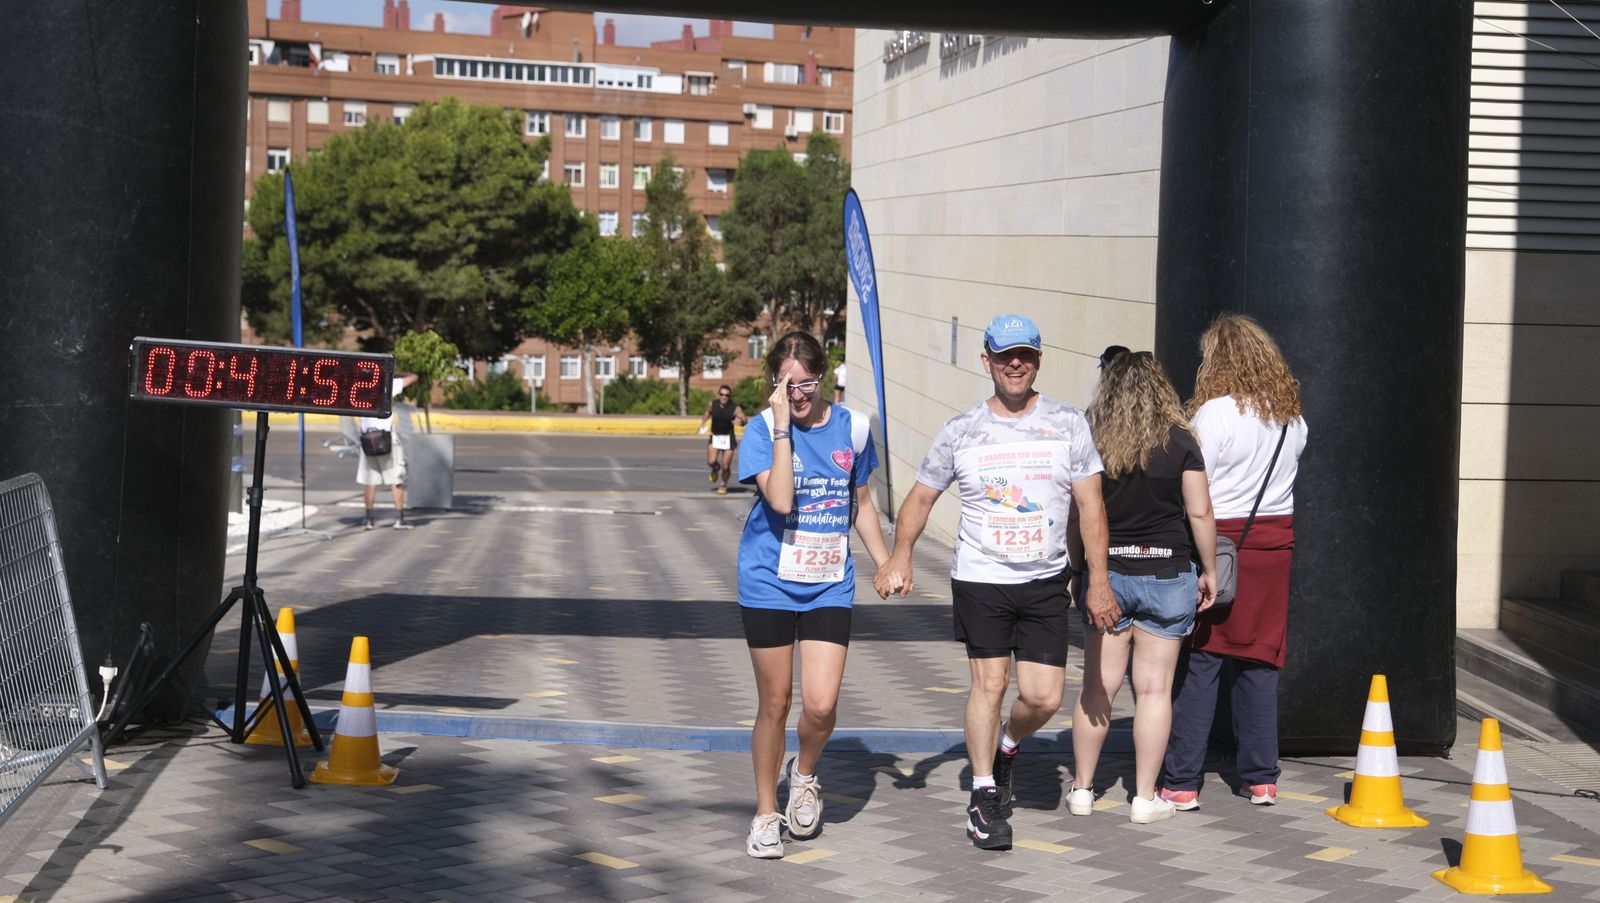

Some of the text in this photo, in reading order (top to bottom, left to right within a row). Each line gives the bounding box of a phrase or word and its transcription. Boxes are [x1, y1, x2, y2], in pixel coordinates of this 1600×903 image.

[145, 347, 380, 409] 00:41:52
[810, 484, 828, 498] azul
[992, 528, 1043, 545] 1234
[793, 549, 841, 565] 1235
